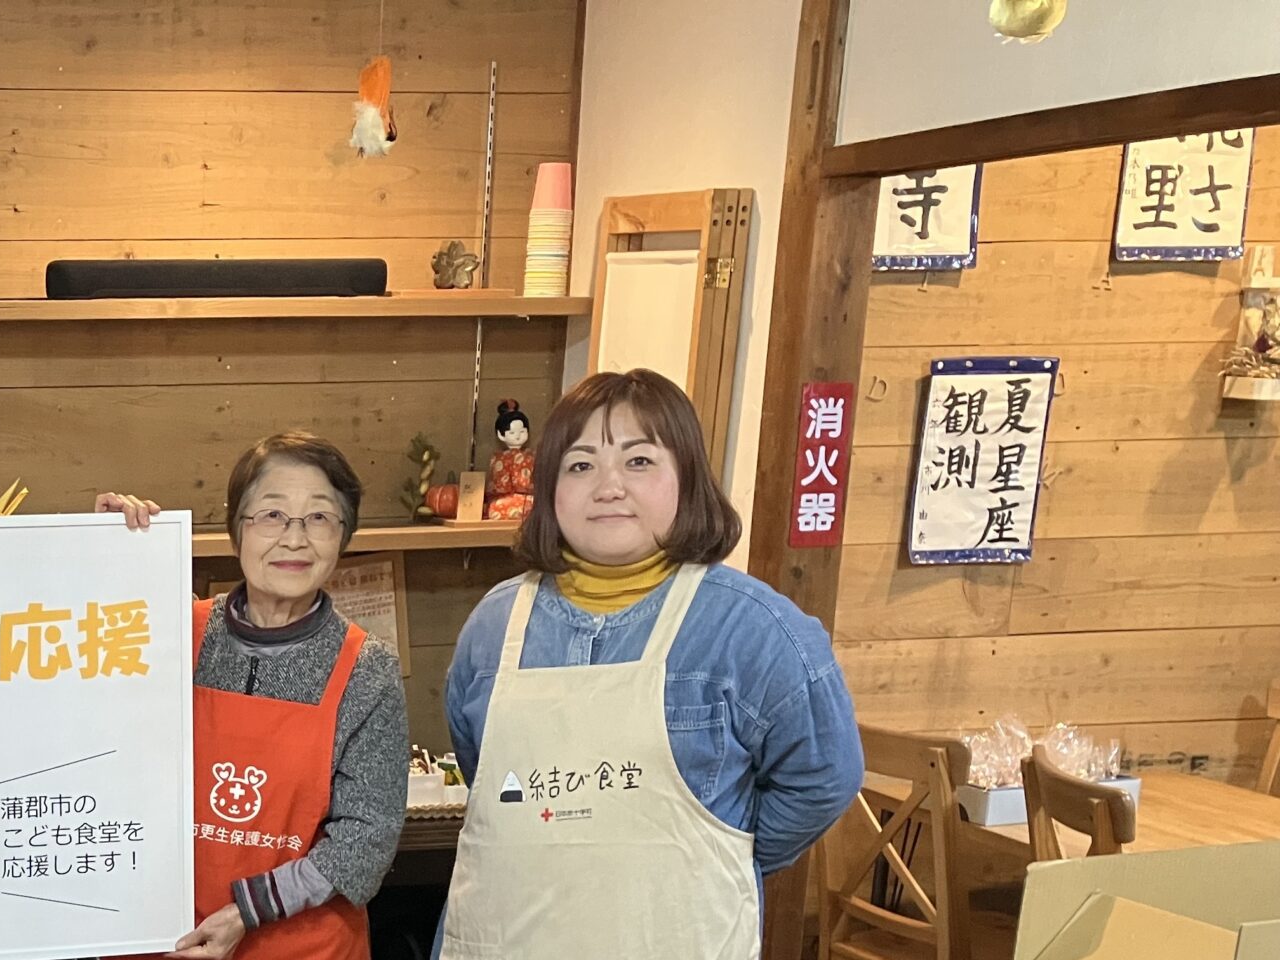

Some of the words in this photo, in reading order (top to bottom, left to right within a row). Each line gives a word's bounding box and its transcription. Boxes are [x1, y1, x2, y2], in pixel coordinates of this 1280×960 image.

[931, 385, 989, 491] 観測
[797, 397, 845, 532] 消火器
[975, 378, 1038, 548] 夏星座
[529, 761, 642, 801] 結び食堂
[0, 794, 97, 820] 蒲郡市の
[4, 820, 144, 848] こども食堂を
[1, 851, 137, 879] 応援します！
